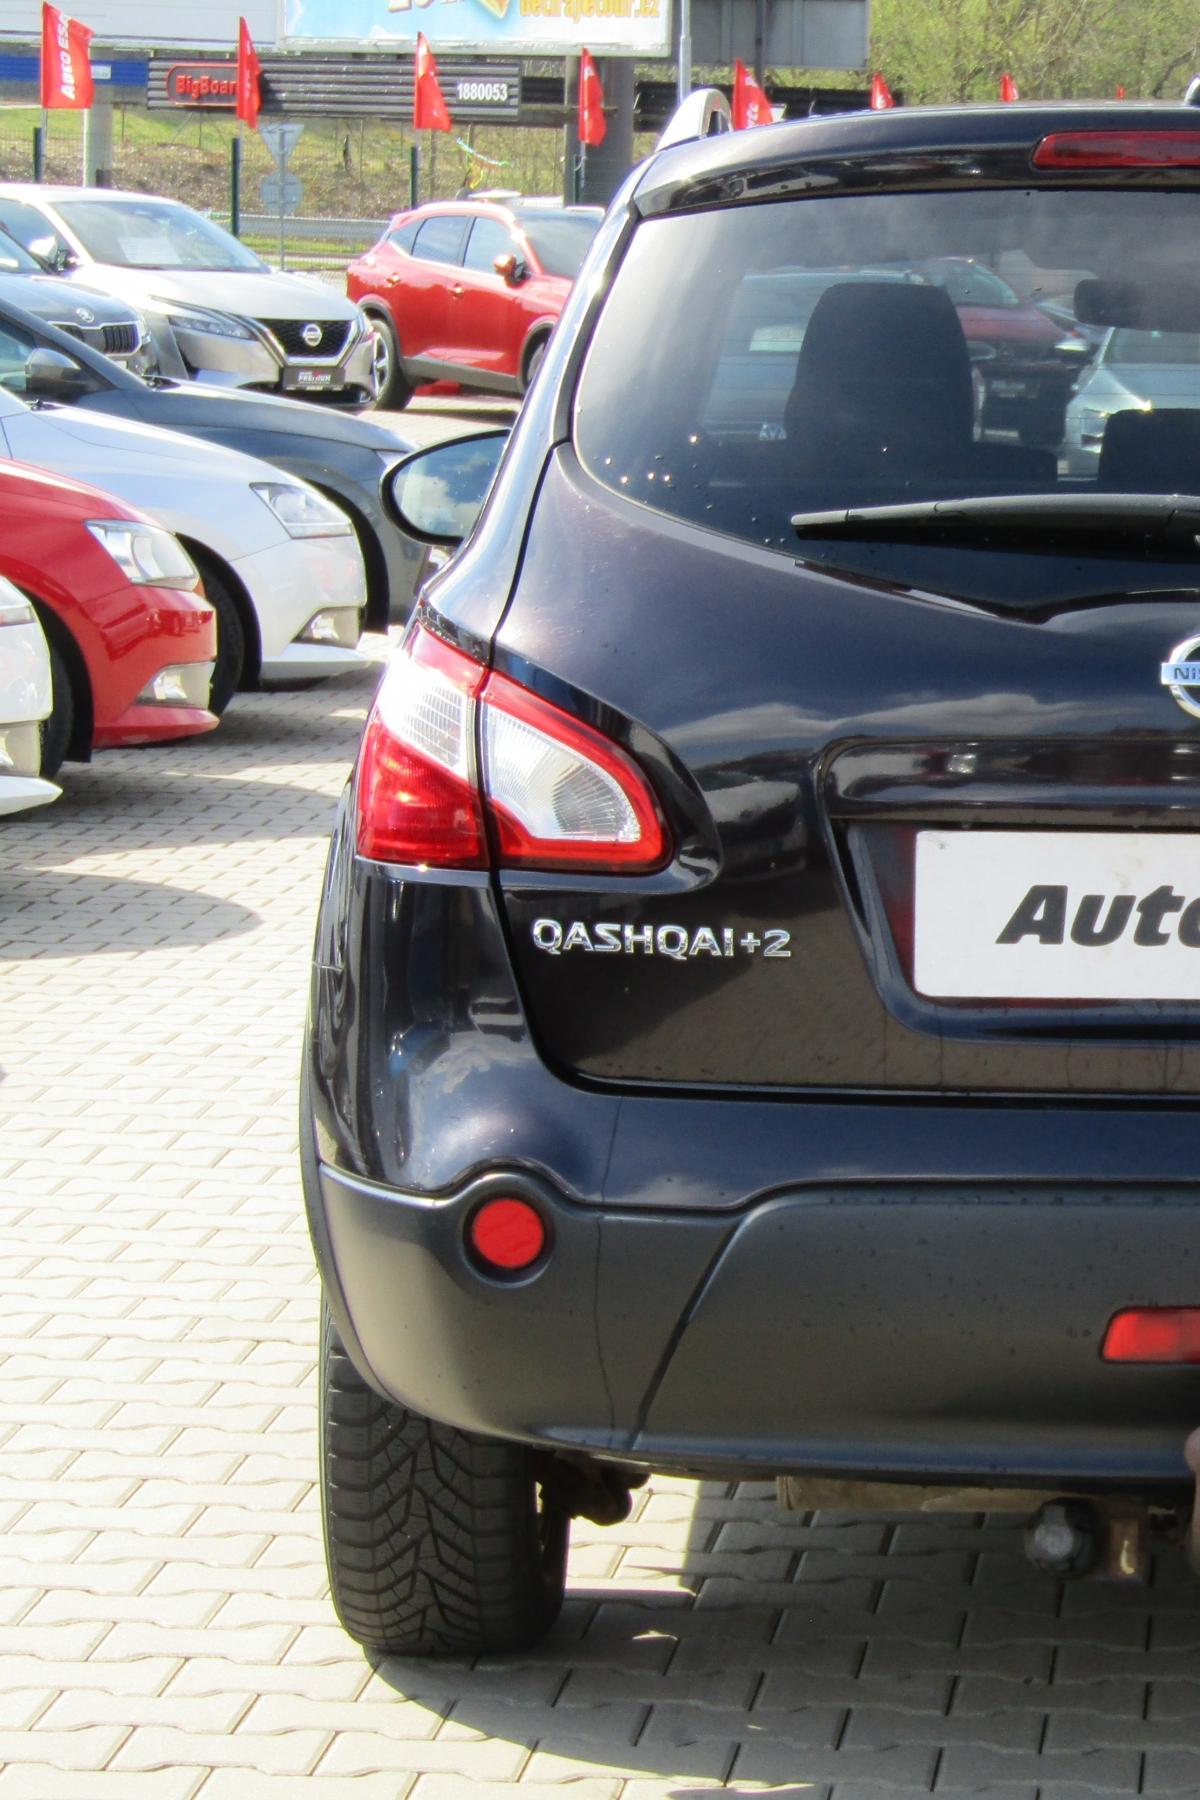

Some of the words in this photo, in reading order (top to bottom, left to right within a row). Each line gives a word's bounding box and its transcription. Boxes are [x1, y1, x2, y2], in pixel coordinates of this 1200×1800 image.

[175, 75, 239, 100] BigBoar
[456, 83, 508, 101] 1880053
[532, 918, 792, 961] QASHQAI+2
